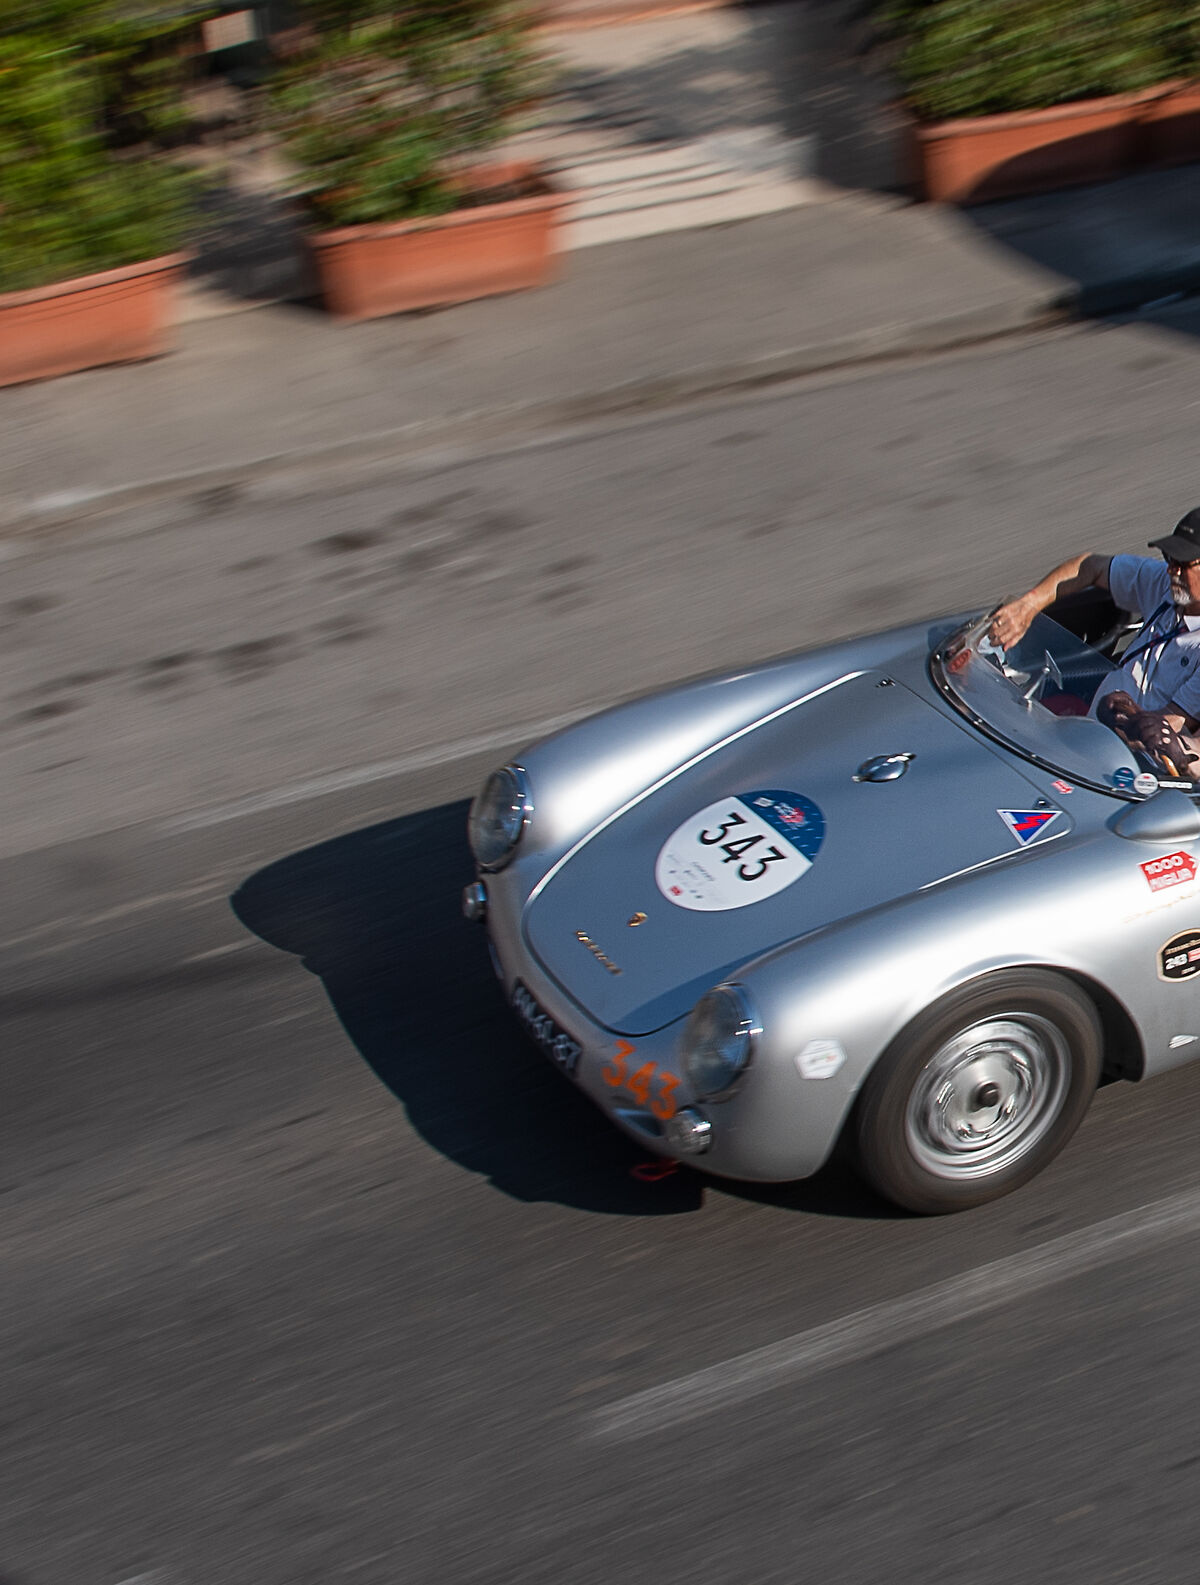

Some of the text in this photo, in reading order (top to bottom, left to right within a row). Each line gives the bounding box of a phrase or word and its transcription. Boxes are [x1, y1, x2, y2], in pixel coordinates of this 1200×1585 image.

[699, 811, 788, 882] 343
[1144, 855, 1184, 875] 1000
[602, 1038, 683, 1120] 343
